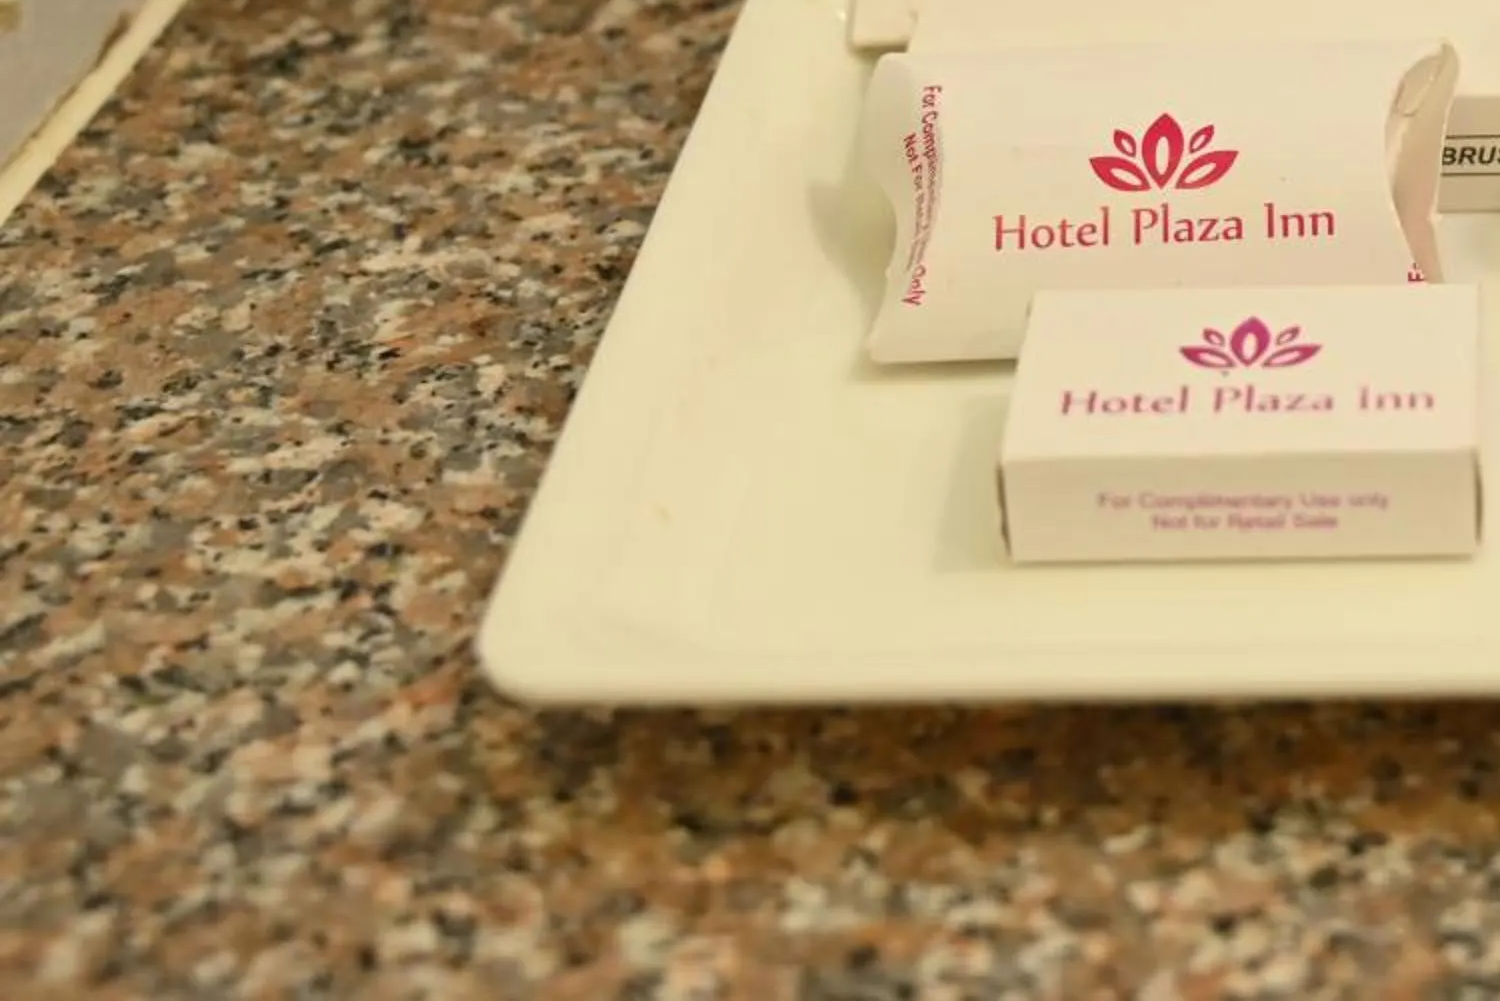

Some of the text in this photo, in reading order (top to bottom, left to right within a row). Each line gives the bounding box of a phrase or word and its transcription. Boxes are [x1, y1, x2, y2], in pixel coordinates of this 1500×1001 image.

[903, 133, 919, 164] Not
[993, 203, 1336, 251] Hotel Plaza Inn
[1060, 383, 1435, 416] Hotel Plaza Inn
[1098, 492, 1131, 509] For
